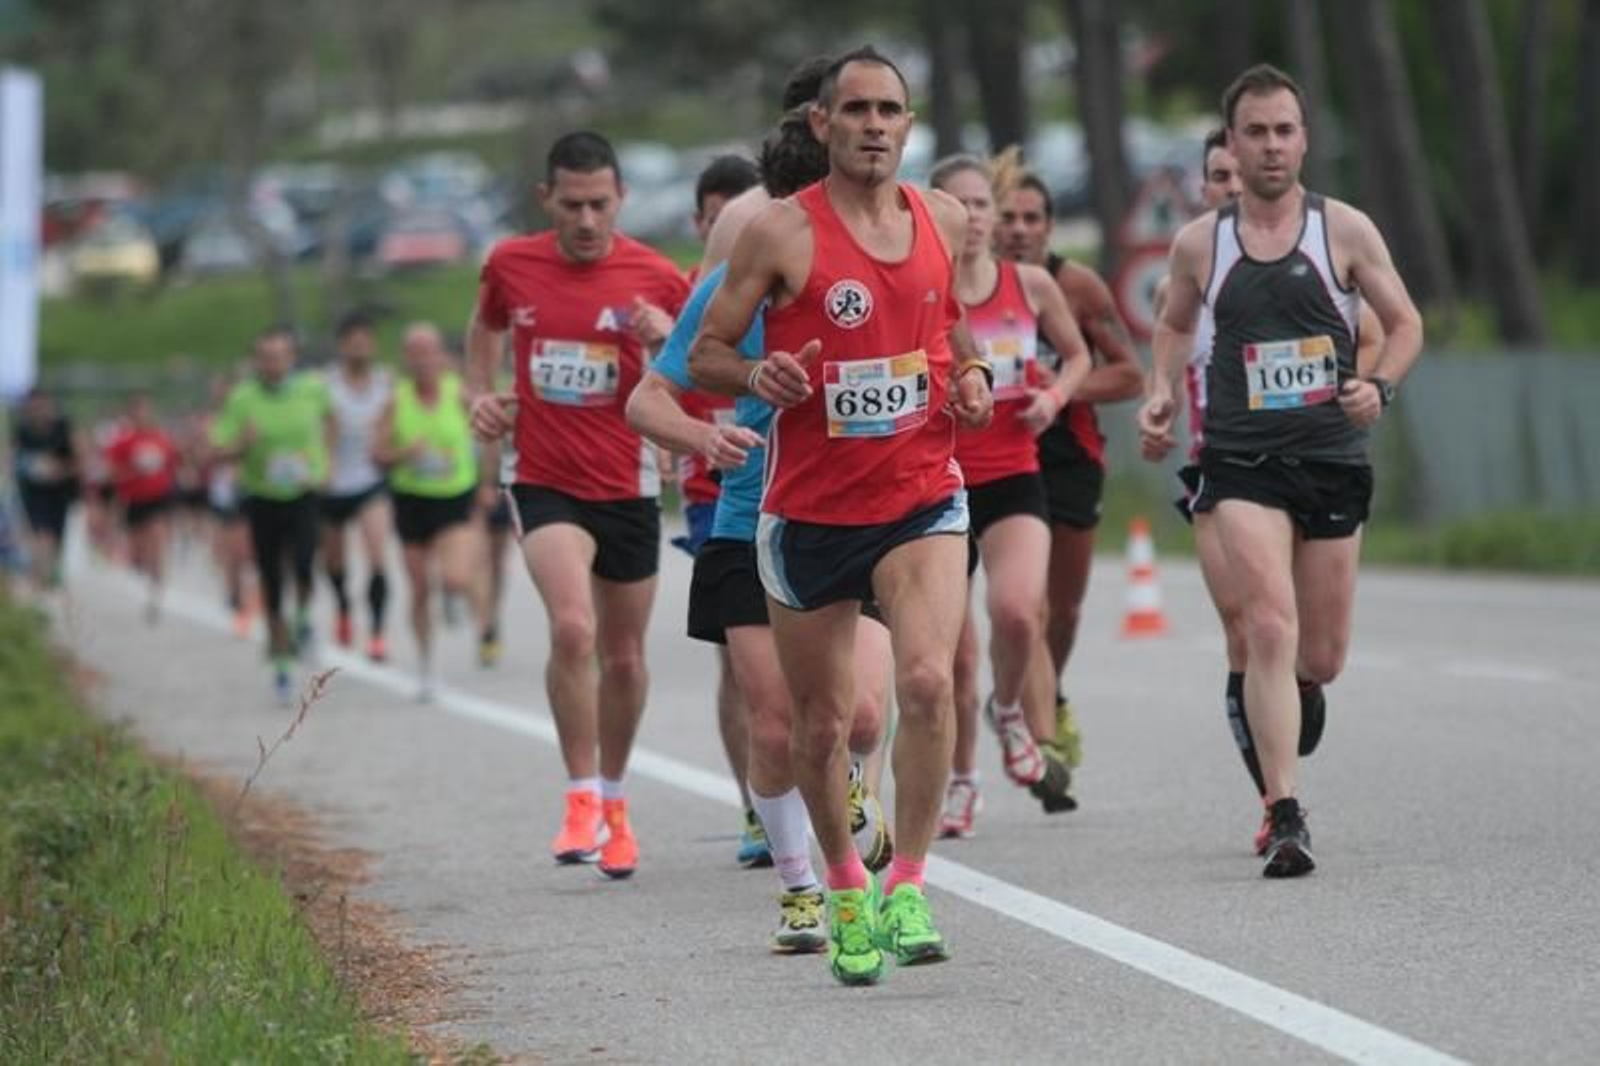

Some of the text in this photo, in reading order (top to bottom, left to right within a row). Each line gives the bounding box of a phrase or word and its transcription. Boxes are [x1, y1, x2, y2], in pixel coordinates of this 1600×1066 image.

[540, 362, 597, 388] 779
[1259, 364, 1315, 390] 106
[834, 384, 907, 417] 689
